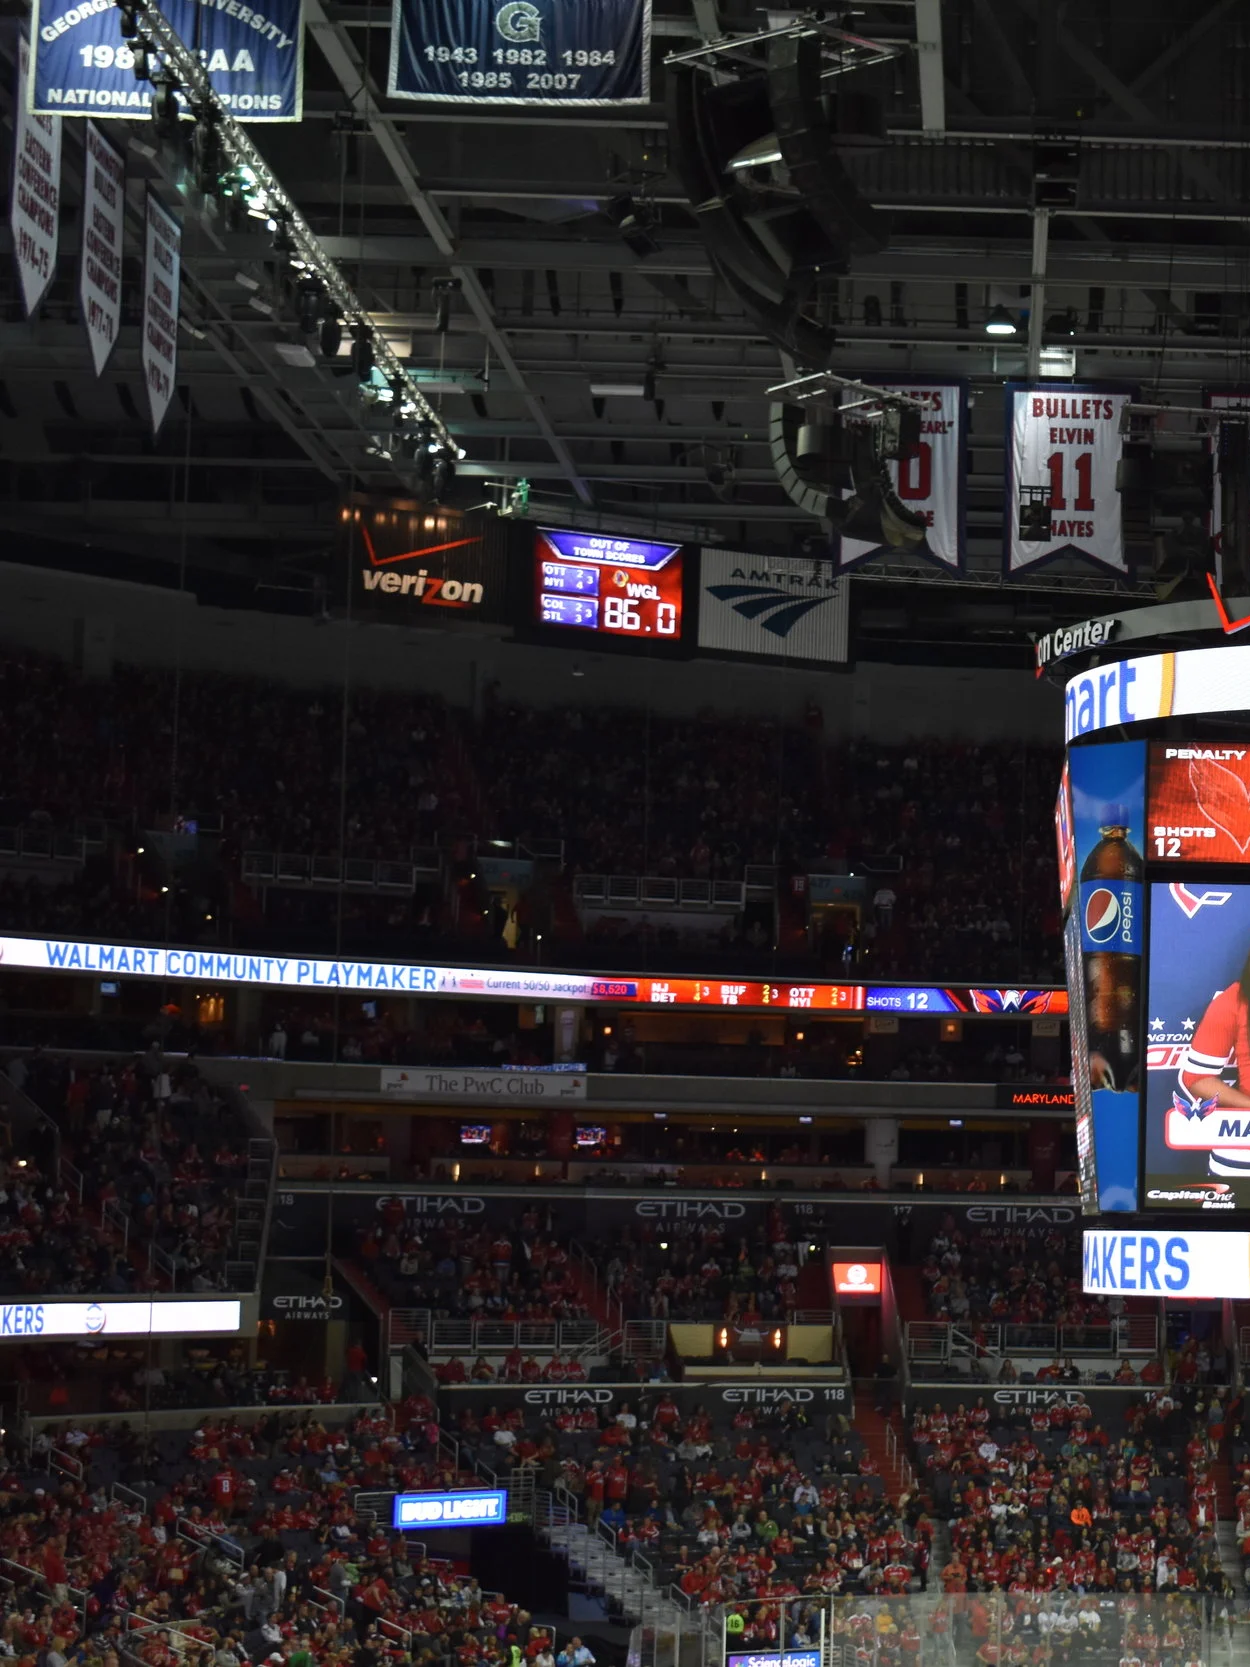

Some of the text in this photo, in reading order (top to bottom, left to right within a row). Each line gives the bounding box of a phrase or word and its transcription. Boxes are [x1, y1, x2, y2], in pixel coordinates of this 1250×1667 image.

[495, 1, 541, 42] G
[424, 46, 616, 66] 1943 1982 1984
[458, 71, 581, 90] 1985 2007
[48, 89, 151, 107] NATIONAL
[1032, 397, 1113, 421] BULLETS
[1050, 428, 1095, 445] ELVIN
[1047, 452, 1096, 512] 11
[1048, 519, 1094, 538] HAYES
[590, 538, 631, 552] OUT OF
[573, 547, 645, 564] TOWN SCORES
[544, 567, 567, 576] OTT
[731, 567, 841, 591] AMTRAK
[363, 567, 484, 608] verizon
[544, 578, 565, 587] NYI
[627, 583, 662, 600] WGL
[543, 599, 566, 610] COL
[543, 611, 563, 621] STL
[605, 597, 676, 634] 86.0
[1053, 619, 1115, 656] Center
[1166, 749, 1247, 761] PENALTY
[1153, 827, 1216, 838] SHOTS
[1155, 838, 1181, 857] 12
[1121, 890, 1133, 943] pepsi
[46, 942, 437, 990] WALMART COMMUNTY PLAYMAKER
[486, 978, 521, 990] Current
[523, 980, 550, 991] 50/50
[651, 982, 669, 992] NJ
[720, 985, 747, 996] BUF
[789, 987, 815, 998] OTT
[651, 992, 677, 1003] DET
[721, 995, 739, 1005] TB
[789, 998, 812, 1008] NYI
[867, 992, 929, 1010] SHOTS 12
[425, 1074, 459, 1092] The
[462, 1076, 504, 1095] PwC
[507, 1077, 545, 1096] Club
[635, 1202, 746, 1219] ETIHAD
[794, 1204, 814, 1215] 118
[1201, 1201, 1236, 1209] Bank
[966, 1206, 1076, 1223] ETIHAD
[285, 1311, 331, 1320] AIRWAYS
[524, 1389, 614, 1404] ETIHAD
[721, 1389, 845, 1403] ETIHAD 118
[401, 1501, 442, 1522] BUD
[443, 1498, 499, 1519] LIGHT
